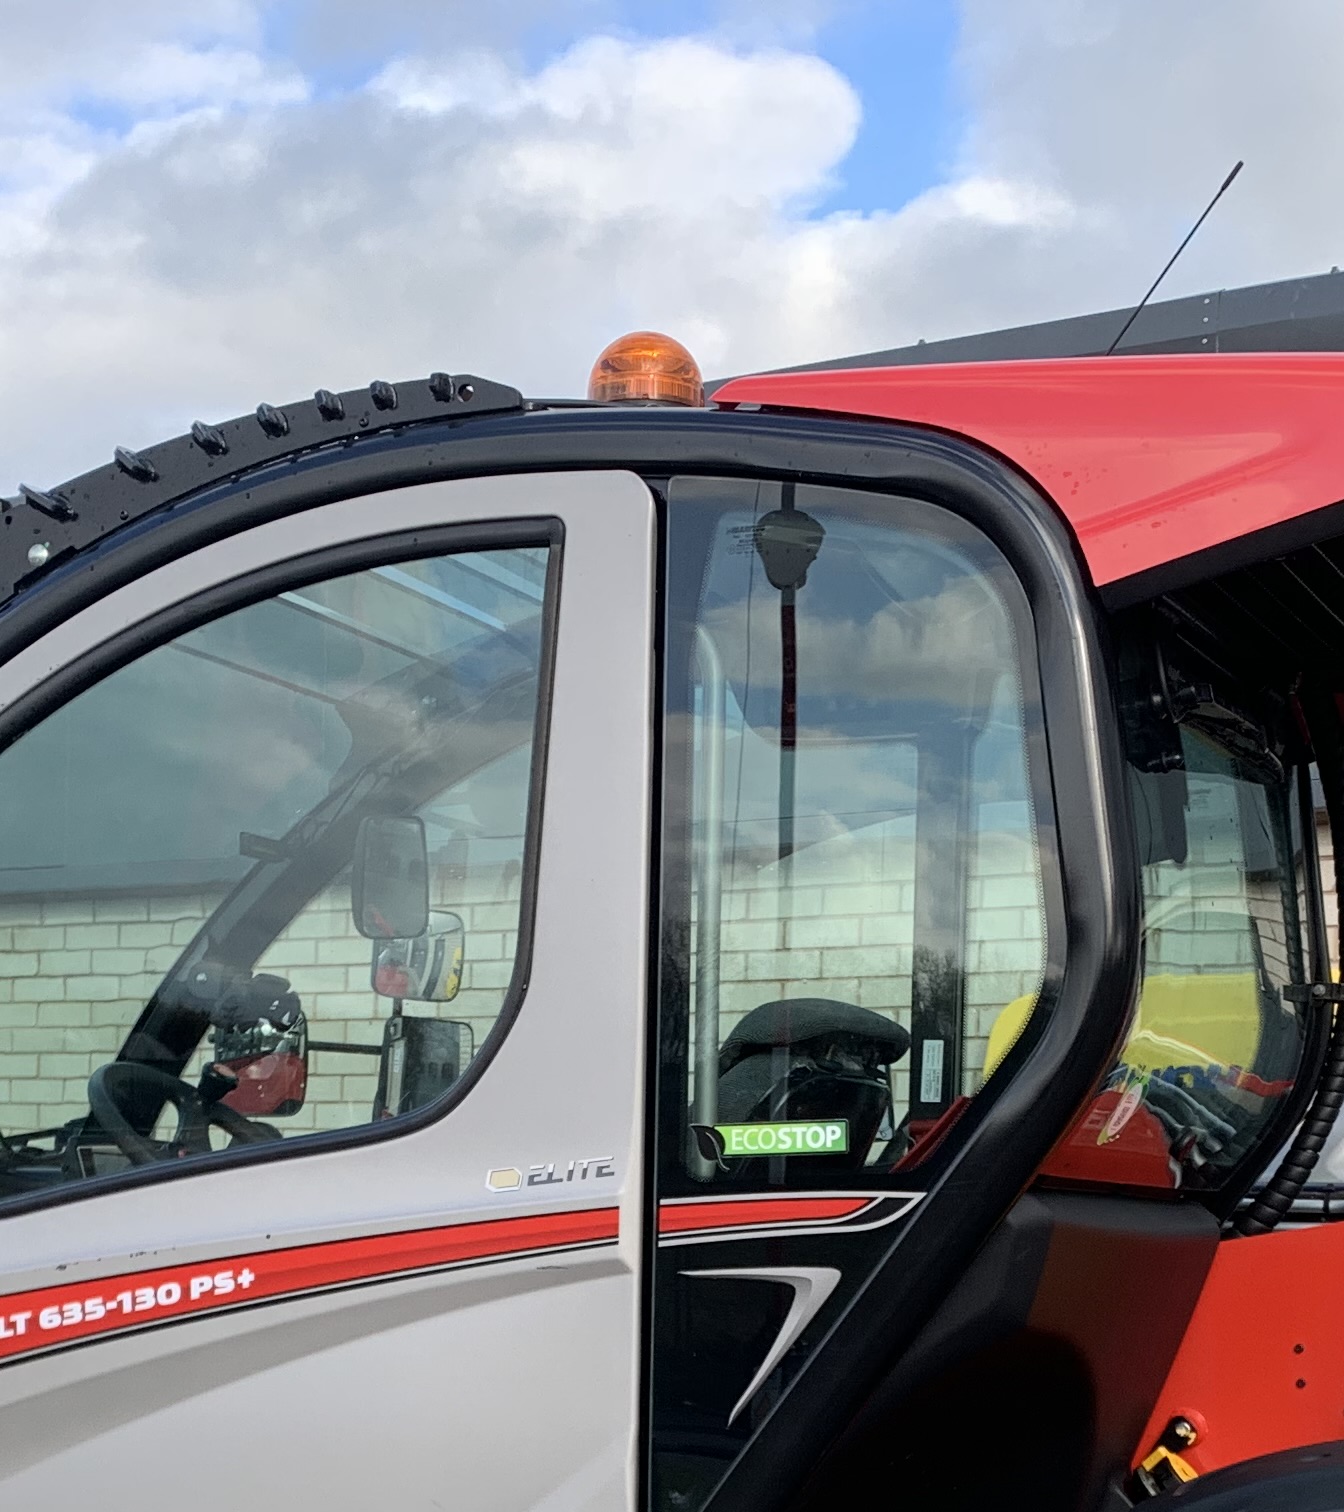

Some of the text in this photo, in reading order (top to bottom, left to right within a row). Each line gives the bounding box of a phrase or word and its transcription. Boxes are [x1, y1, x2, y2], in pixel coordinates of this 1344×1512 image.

[730, 1125, 842, 1151] ECOSTOP
[527, 1155, 615, 1186] ELITE
[38, 1281, 182, 1330] 635-130
[190, 1268, 256, 1300] PS+
